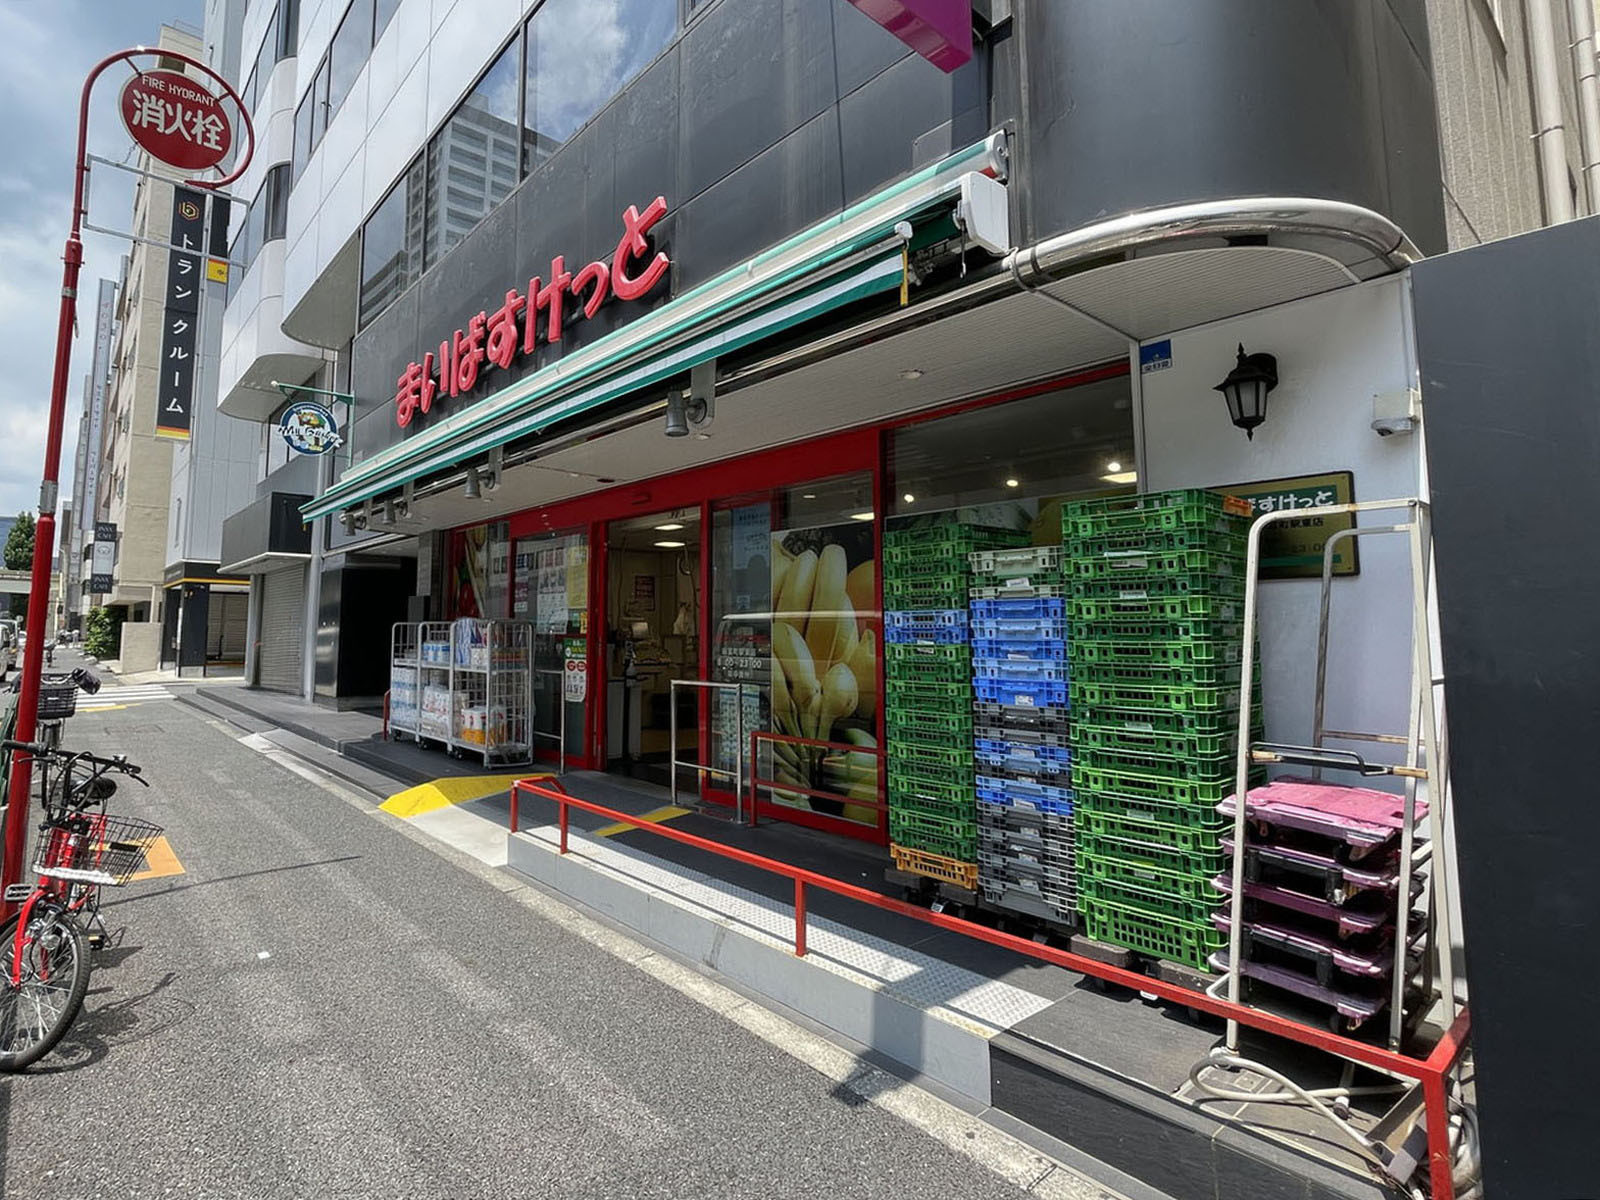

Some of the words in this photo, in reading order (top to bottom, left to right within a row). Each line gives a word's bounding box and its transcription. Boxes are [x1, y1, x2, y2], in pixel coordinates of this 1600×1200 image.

[132, 89, 225, 151] 消火栓
[142, 75, 166, 91] FIRE
[168, 83, 215, 107] HYDRANT
[165, 233, 194, 414] トランクルーム
[395, 196, 670, 429] まいばすけっと
